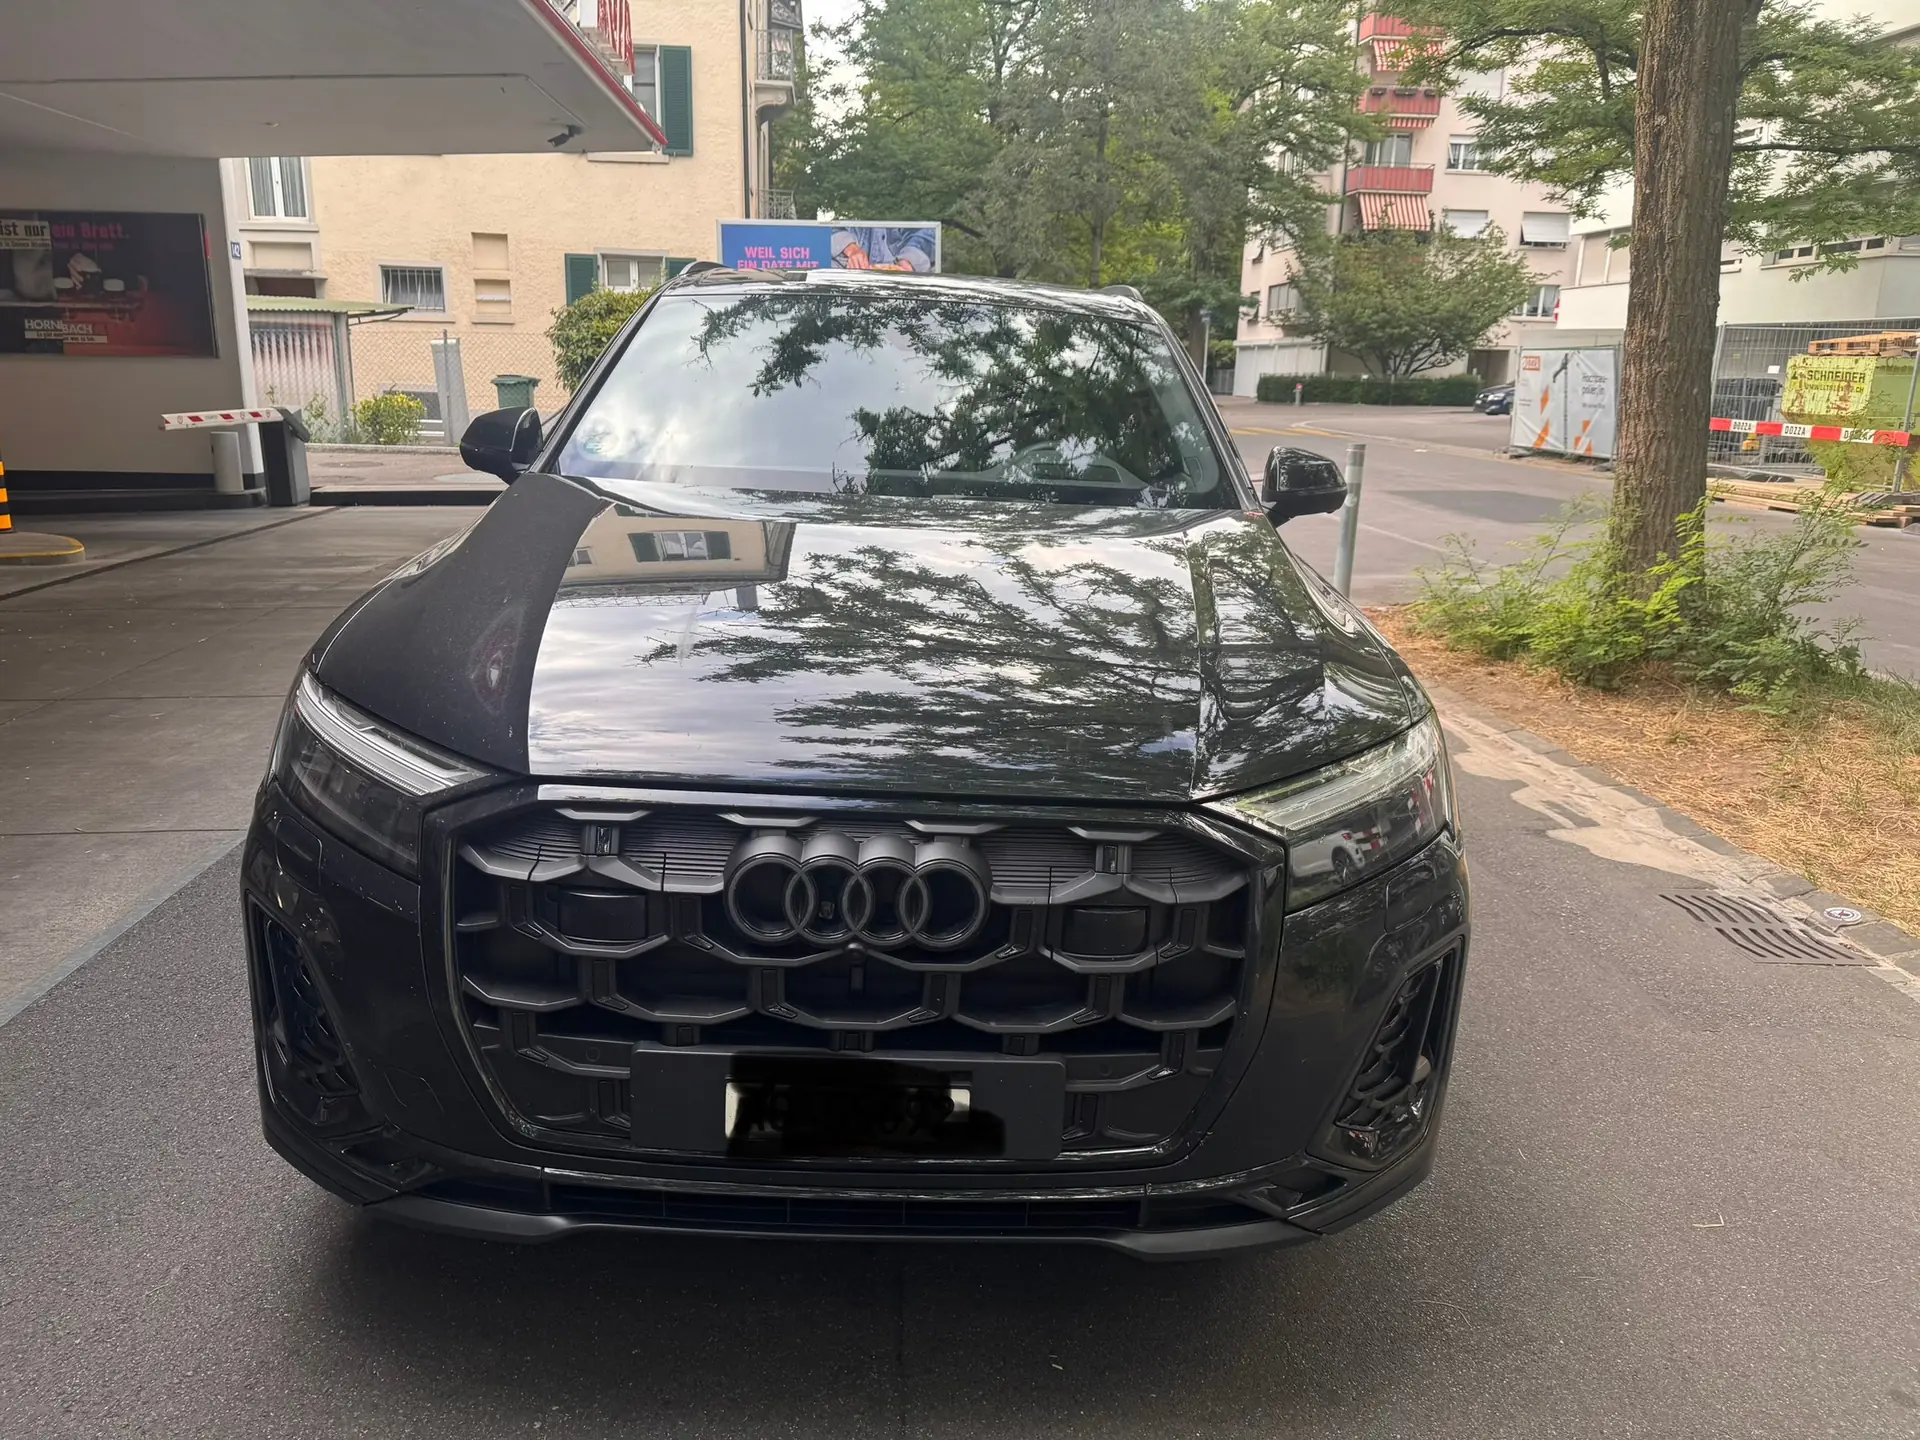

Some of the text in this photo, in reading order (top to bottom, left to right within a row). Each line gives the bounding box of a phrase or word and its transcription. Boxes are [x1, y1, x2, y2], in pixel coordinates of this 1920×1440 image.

[24, 224, 46, 237] nur
[745, 246, 810, 259] WEIL SICH
[737, 260, 819, 269] EIN DATE MIT
[1784, 425, 1806, 436] DOZZA
